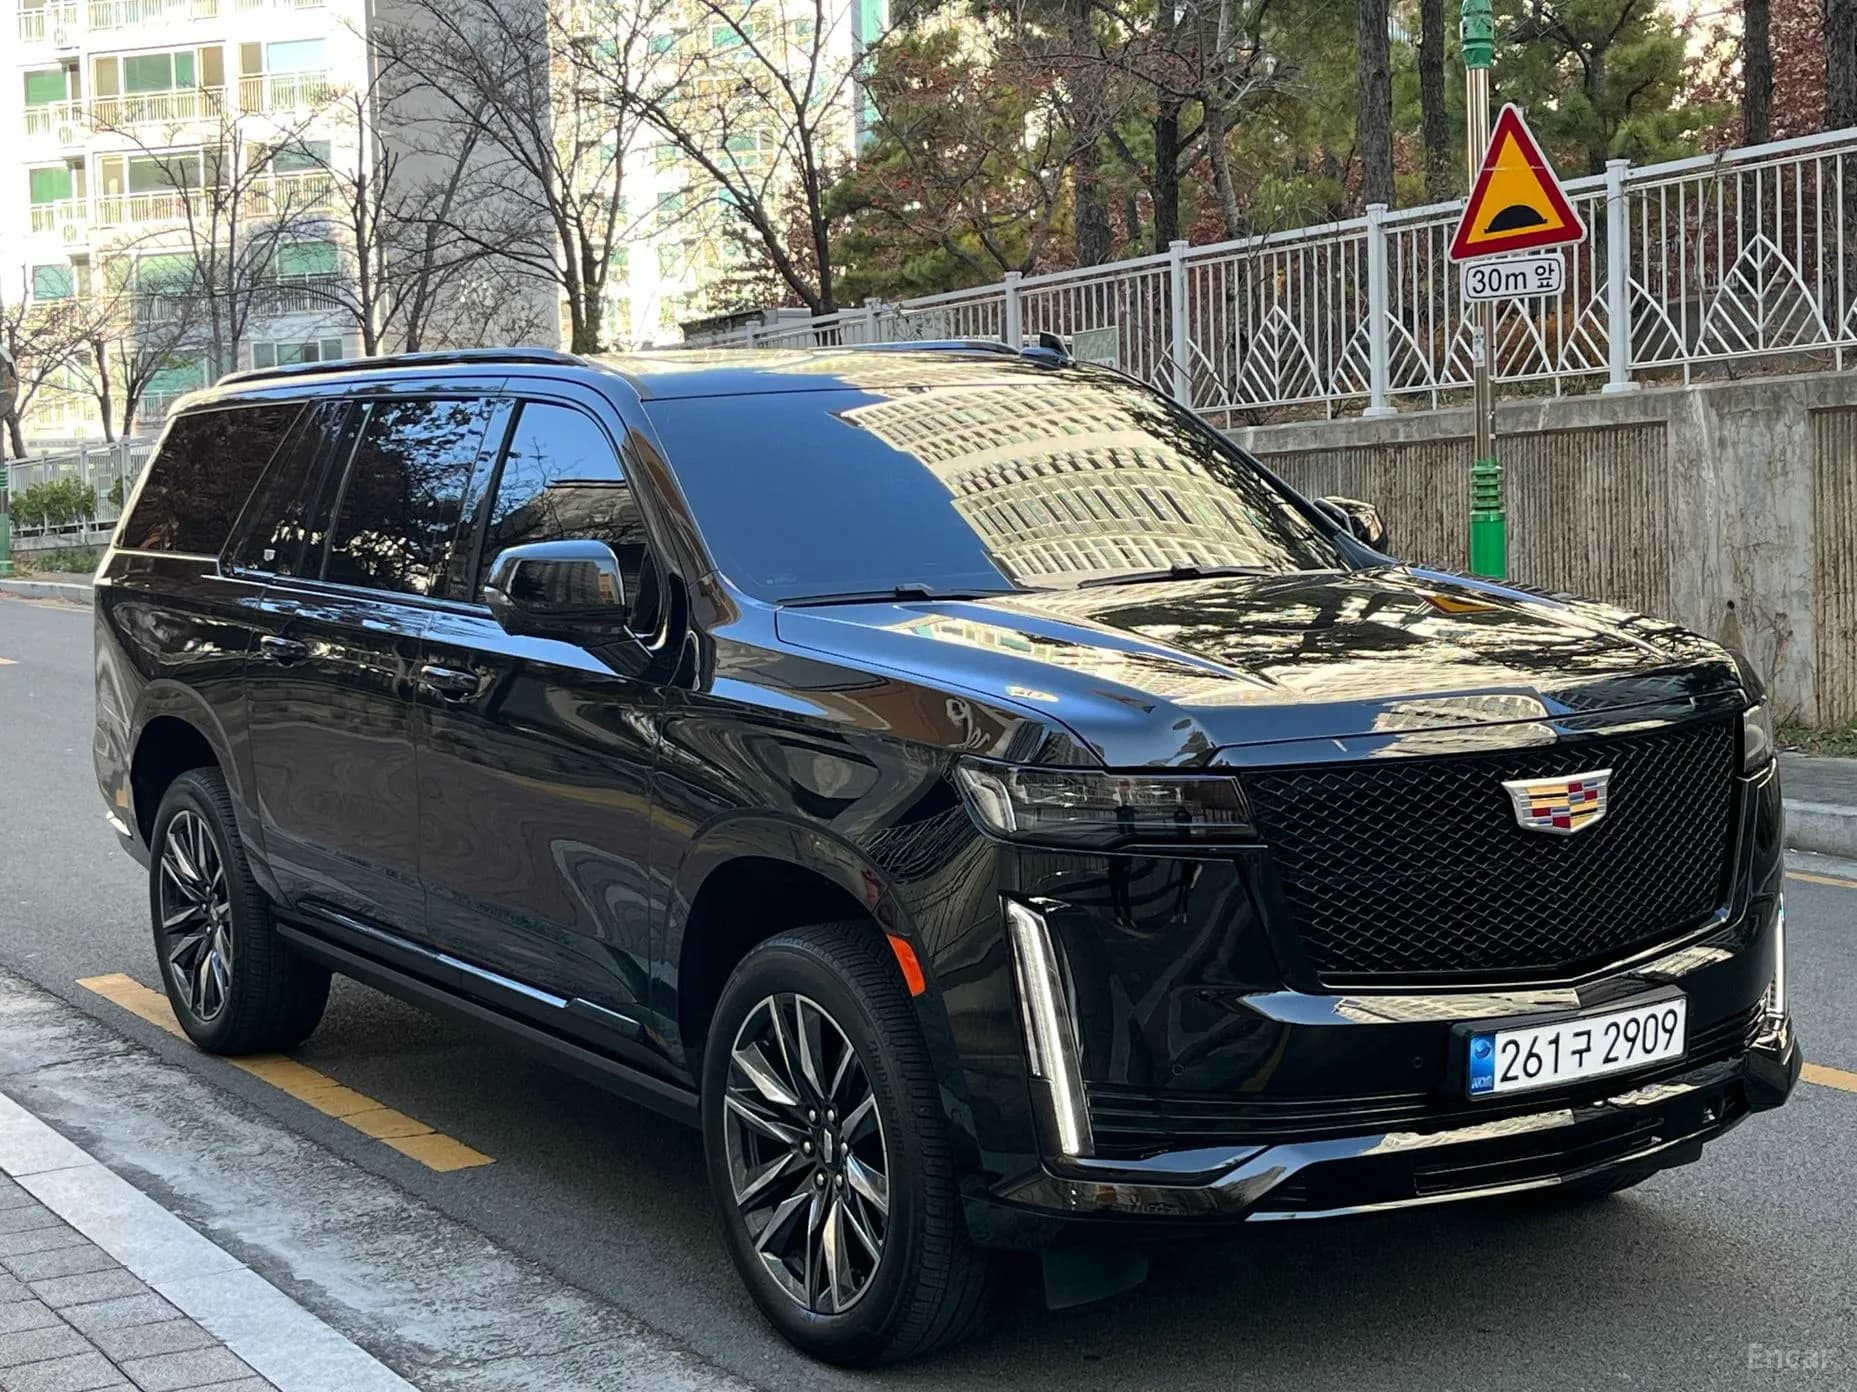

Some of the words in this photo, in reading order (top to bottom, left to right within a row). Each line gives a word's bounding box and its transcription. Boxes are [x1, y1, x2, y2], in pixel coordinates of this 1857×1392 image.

[1472, 268, 1527, 294] 30m
[1535, 262, 1555, 289] 앞
[1602, 1008, 1678, 1065] 2909
